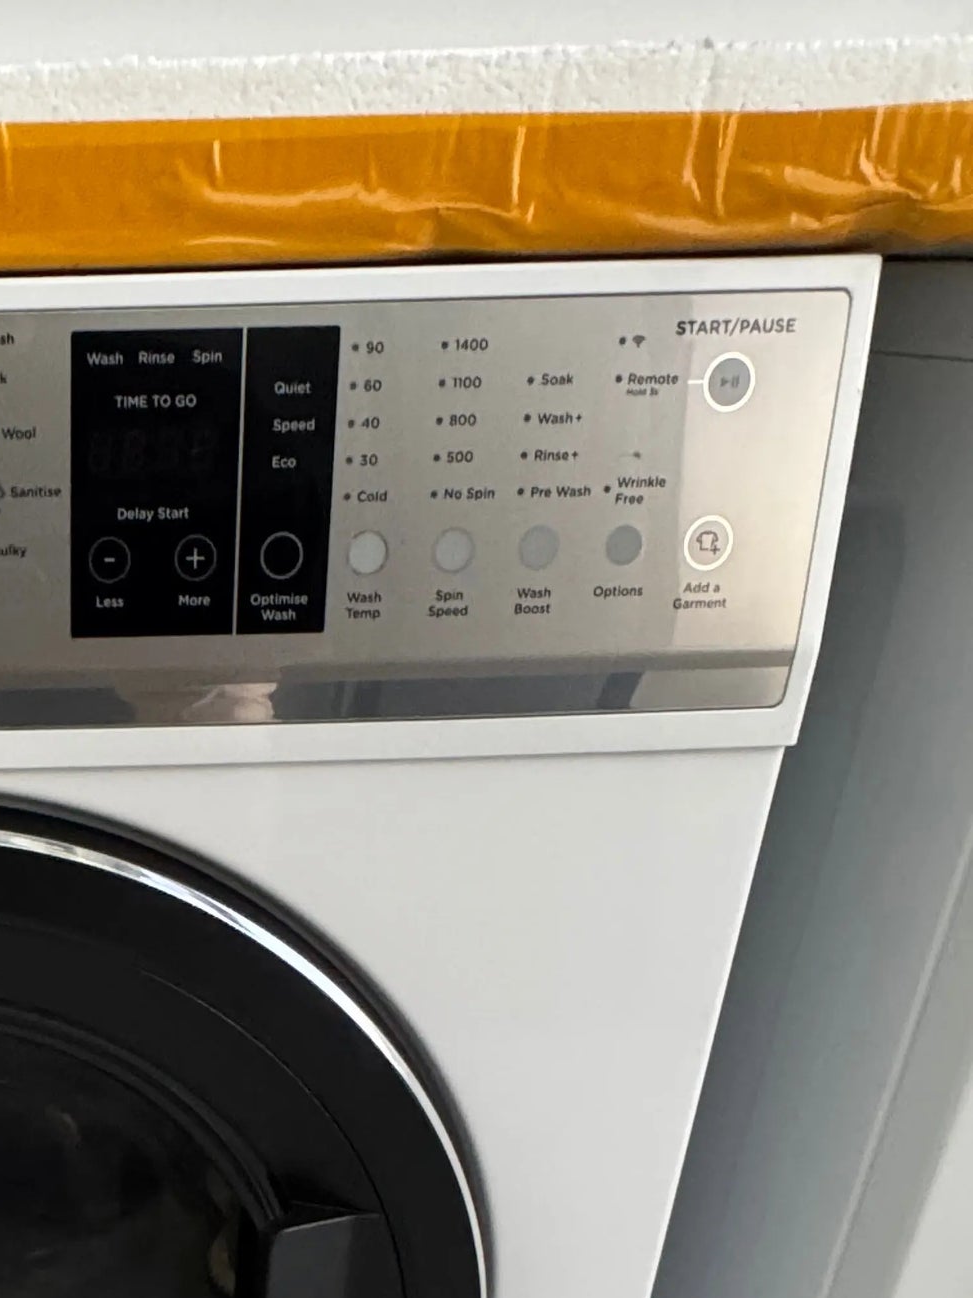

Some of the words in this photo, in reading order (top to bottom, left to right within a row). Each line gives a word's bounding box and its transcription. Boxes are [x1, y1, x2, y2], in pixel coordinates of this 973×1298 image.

[676, 318, 796, 336] START/PAUSE
[366, 341, 384, 354] 90
[455, 339, 489, 351] 1400
[87, 352, 123, 365] Wash
[139, 351, 175, 364] Rinse
[192, 349, 223, 364] Spin
[453, 376, 482, 389] 1100
[541, 373, 574, 386] Soak
[627, 373, 678, 386] Remote
[274, 381, 311, 394] Quiet
[364, 380, 382, 392] 60
[115, 395, 148, 408] TIME
[152, 394, 171, 408] TO
[175, 394, 197, 407] GO
[272, 418, 315, 433] Speed
[361, 417, 380, 429] 40
[449, 415, 476, 427] 800
[2, 426, 36, 440] Wool
[272, 455, 296, 468] Eco
[360, 454, 378, 466] 30
[446, 451, 473, 464] 500
[617, 475, 666, 489] Wrinkle
[10, 487, 61, 498] Sanitise
[357, 490, 388, 502] Cold
[443, 489, 462, 500] No
[466, 488, 495, 501] Spin
[530, 487, 551, 498] Pre
[556, 486, 591, 498] Wash
[615, 493, 644, 505] Free
[117, 508, 154, 522] Delay
[157, 507, 189, 520] Start
[517, 587, 551, 599] Wash
[593, 585, 643, 598] Options
[683, 582, 709, 594] Add
[713, 584, 721, 593] a
[96, 596, 124, 608] Less
[178, 595, 211, 607] More
[250, 593, 308, 607] Optimise
[347, 592, 382, 603] Wash
[435, 590, 464, 602] Spin
[514, 604, 550, 615] Boost
[673, 598, 727, 610] Garment
[261, 609, 296, 621] Wash
[346, 608, 380, 620] Temp
[428, 606, 468, 618] Speed
